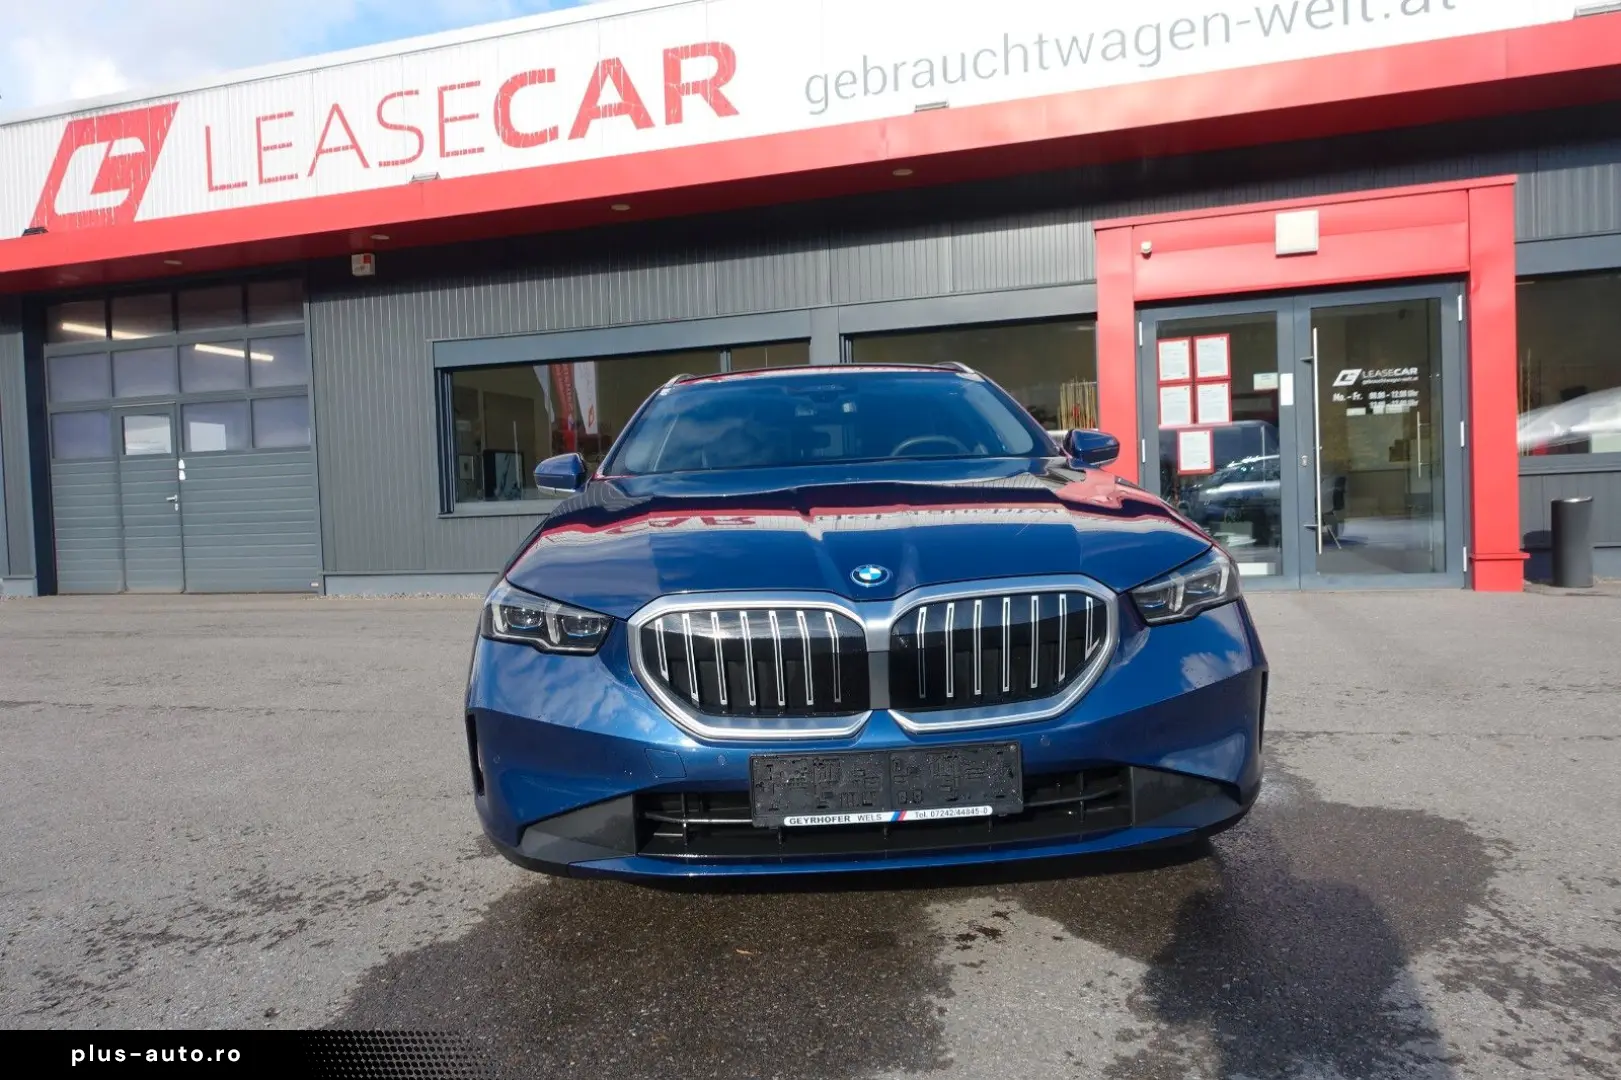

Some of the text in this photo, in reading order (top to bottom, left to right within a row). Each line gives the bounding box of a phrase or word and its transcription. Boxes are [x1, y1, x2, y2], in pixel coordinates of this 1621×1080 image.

[204, 40, 740, 192] LEASECAR
[1362, 367, 1418, 378] LEASECAR
[789, 815, 851, 826] GEYRHOFER
[857, 813, 882, 822] WELS
